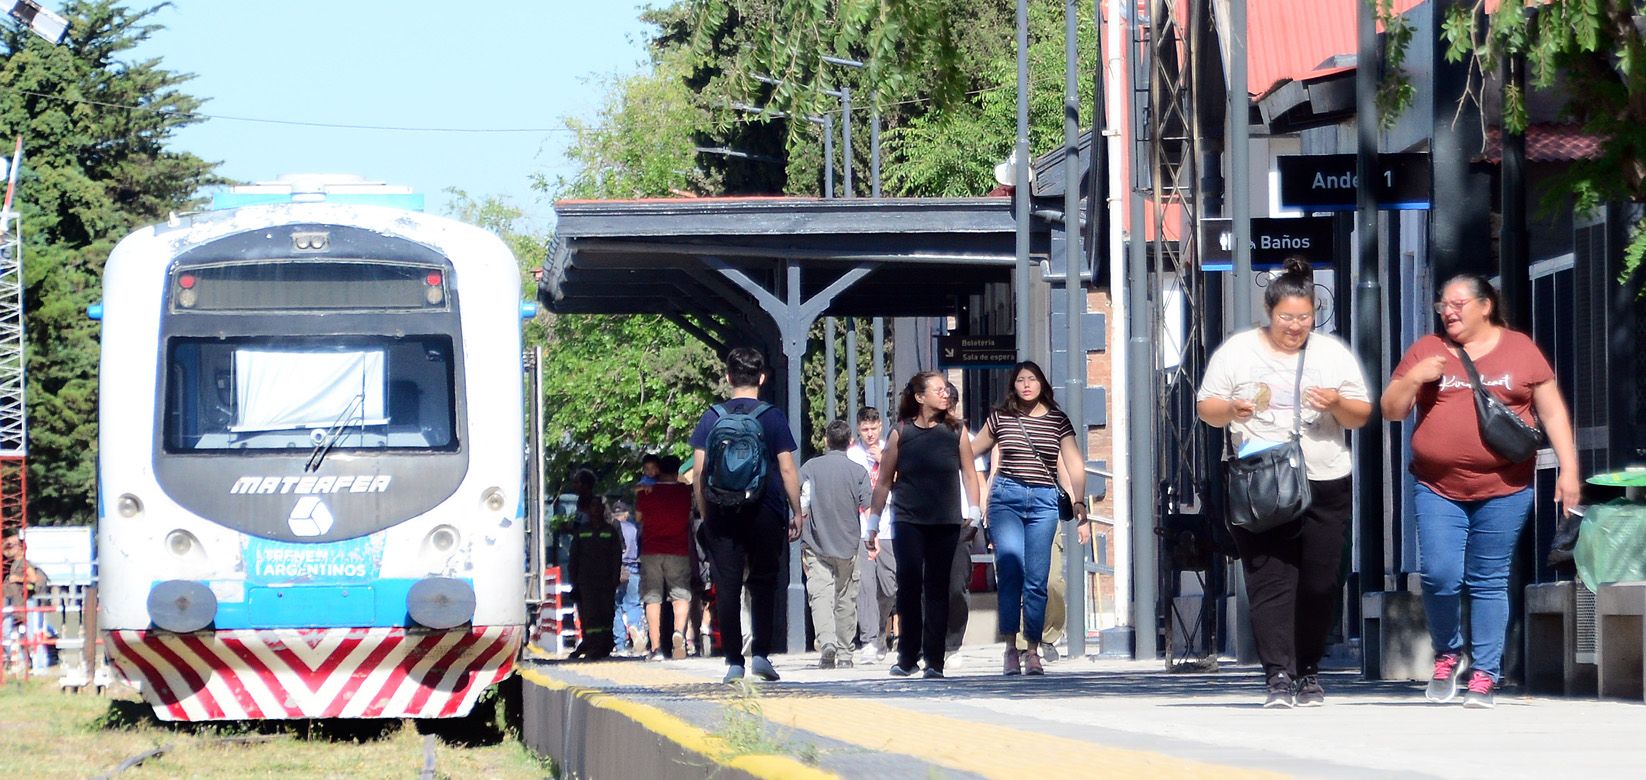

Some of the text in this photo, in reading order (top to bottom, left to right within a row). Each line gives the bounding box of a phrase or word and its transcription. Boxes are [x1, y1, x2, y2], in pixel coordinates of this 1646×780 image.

[1311, 170, 1392, 189] Ande 1
[1260, 234, 1310, 249] Baños
[962, 353, 1015, 362] Sala de espera
[263, 563, 366, 577] ARGENTINOS
